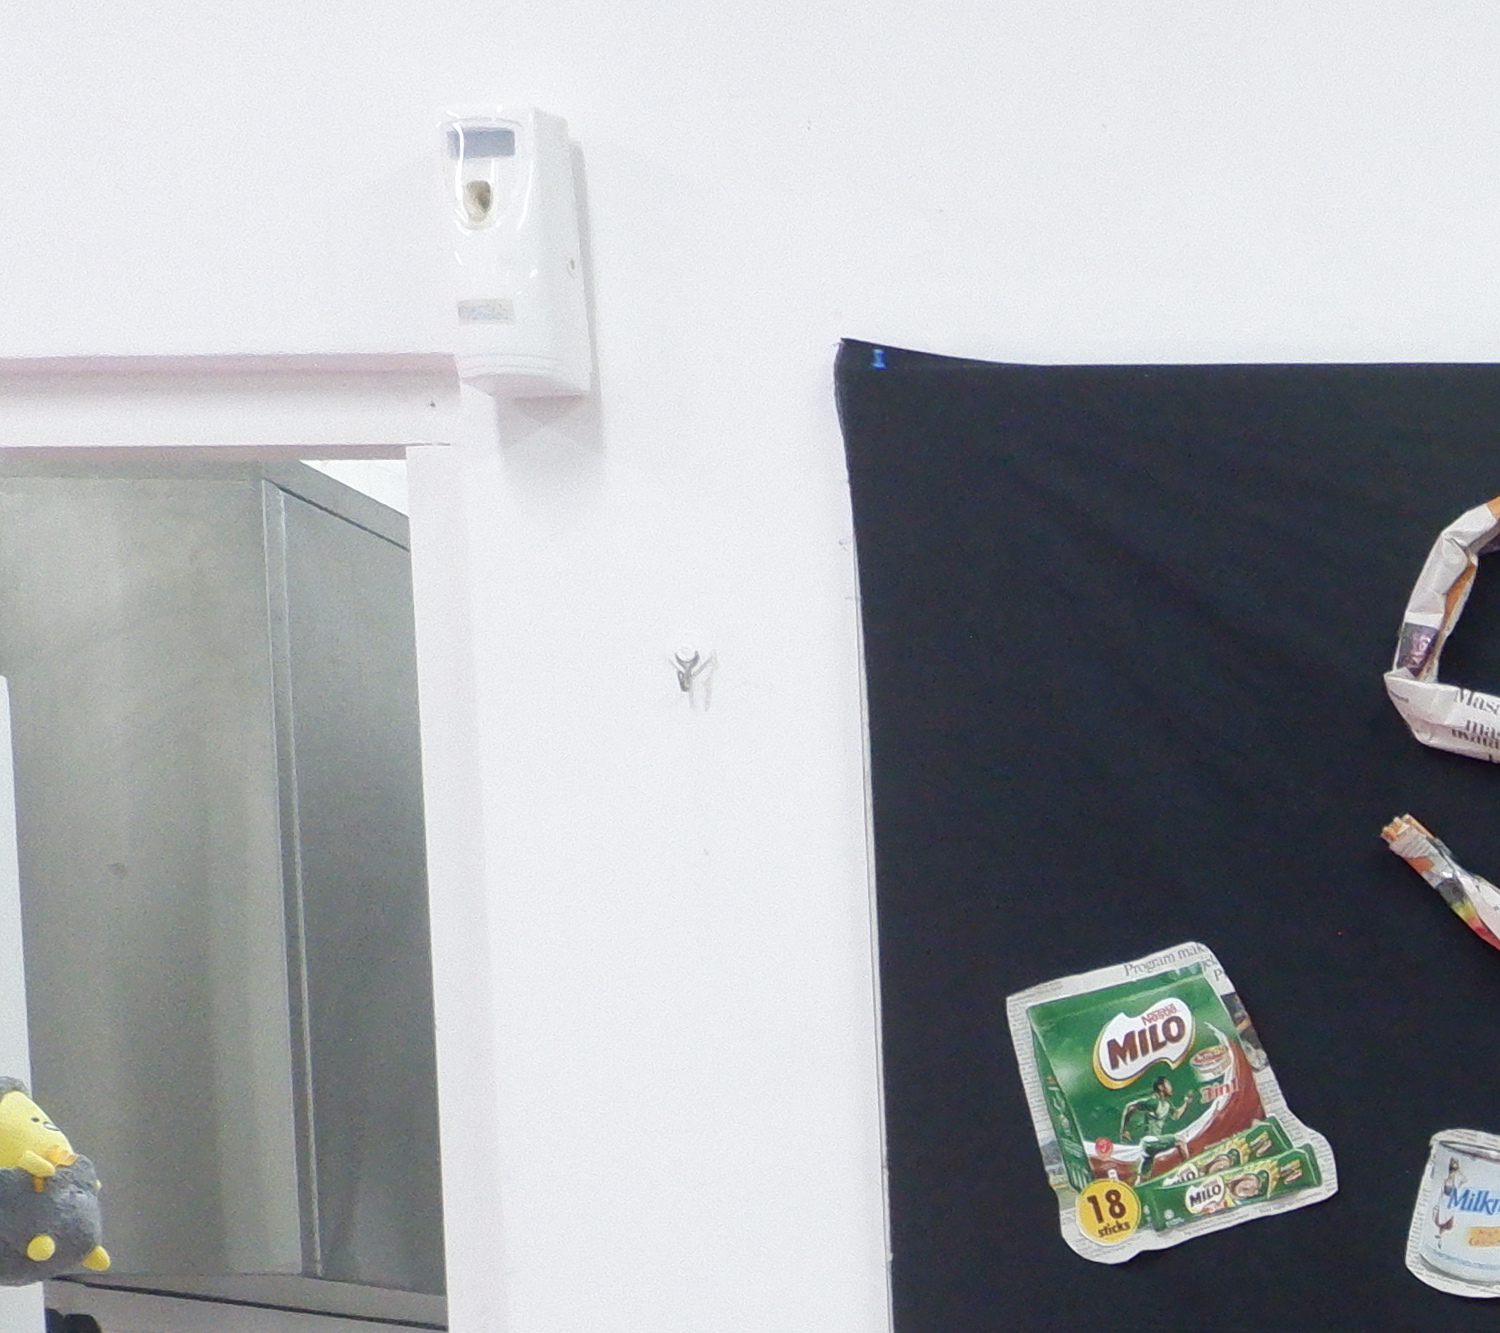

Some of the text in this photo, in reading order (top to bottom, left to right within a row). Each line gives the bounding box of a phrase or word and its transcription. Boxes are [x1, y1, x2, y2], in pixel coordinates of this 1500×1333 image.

[1123, 952, 1176, 977] Program
[1106, 1015, 1186, 1071] MILO
[1086, 1188, 1127, 1225] 18
[1097, 1220, 1131, 1238] sticks
